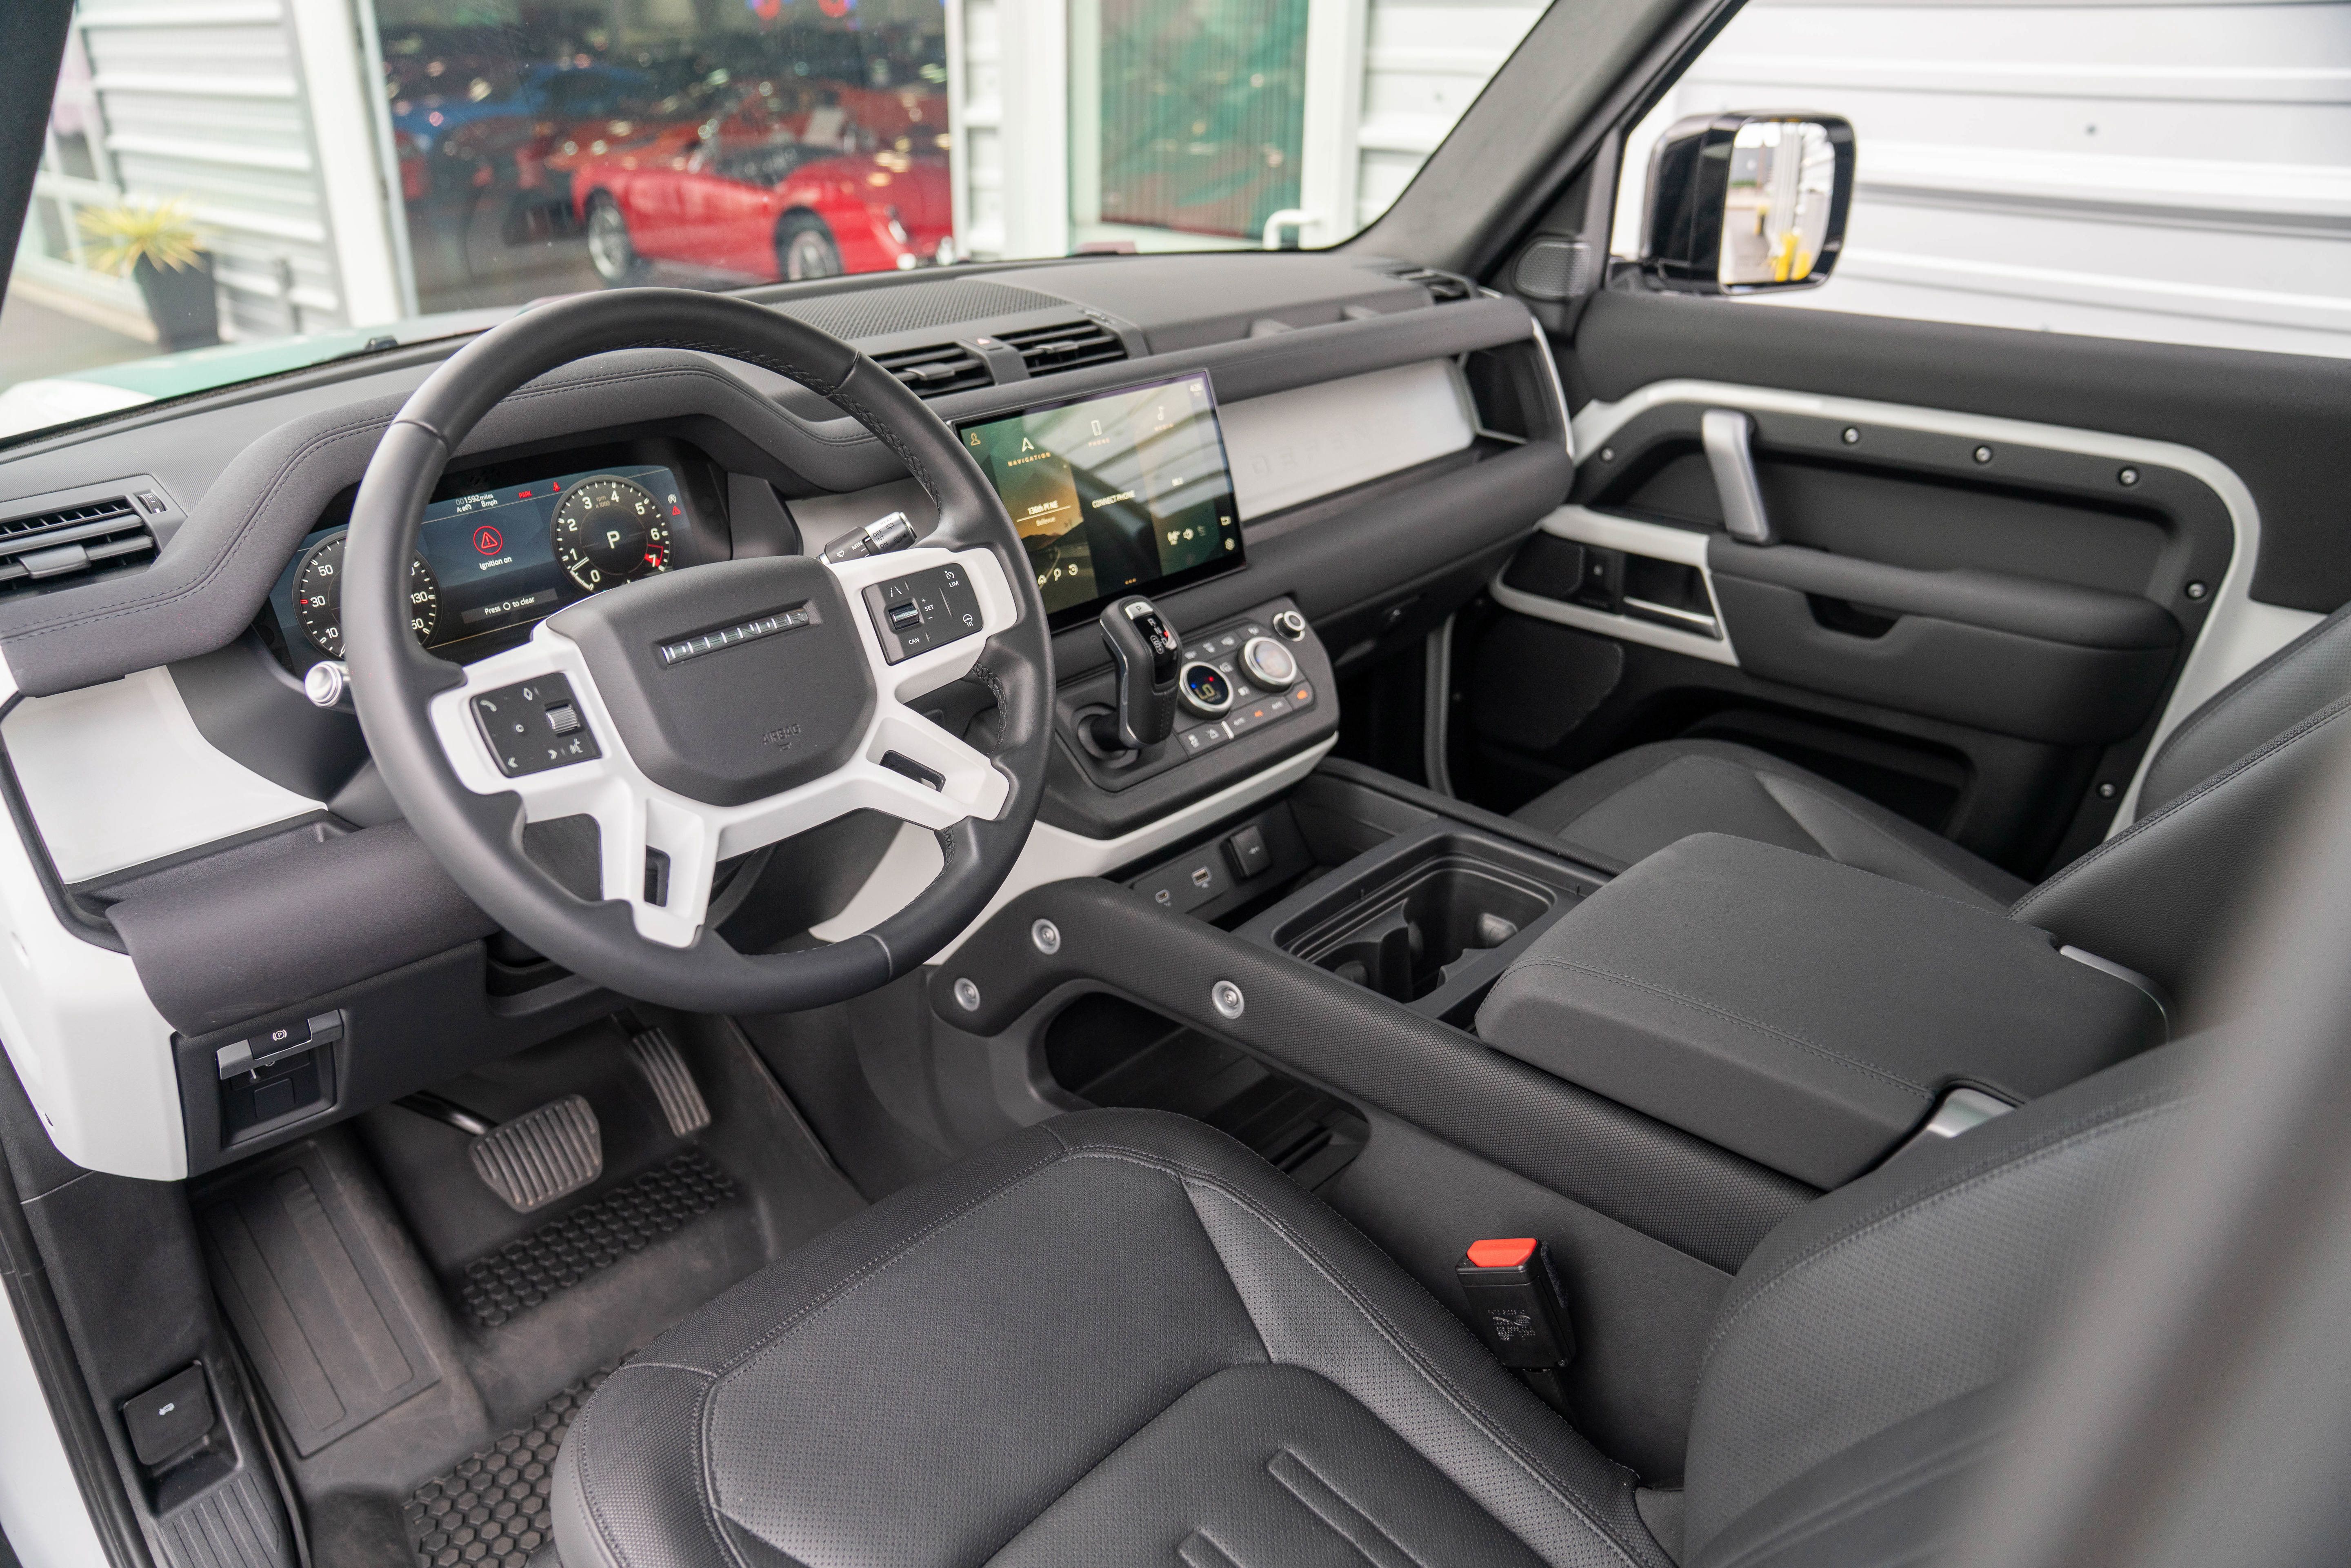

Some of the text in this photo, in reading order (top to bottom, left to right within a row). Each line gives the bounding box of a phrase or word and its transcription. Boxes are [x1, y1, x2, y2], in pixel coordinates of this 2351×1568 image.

[1007, 452, 1051, 467] NAVIGATION
[518, 491, 532, 499] PARK
[611, 490, 620, 502] 4
[1092, 490, 1136, 508] CONNECT PHONE
[582, 496, 592, 509] 3
[635, 502, 645, 515] 5
[567, 518, 578, 531] 2
[1036, 516, 1056, 526] Bellevue
[607, 530, 620, 549] P
[650, 527, 660, 541] 6
[873, 529, 882, 537] OFF
[851, 541, 863, 551] MIN
[570, 548, 578, 560] 1
[648, 554, 657, 567] 7
[318, 564, 333, 577] 50
[479, 559, 503, 571] Ignition
[590, 569, 600, 582] 0
[310, 595, 326, 607] 30
[410, 591, 428, 604] 130
[484, 606, 501, 615] Press
[520, 597, 535, 605] clear
[411, 618, 424, 630] 50
[325, 627, 338, 639] 10
[669, 613, 806, 659] DEFENDER
[762, 723, 801, 745] AIRBAG
